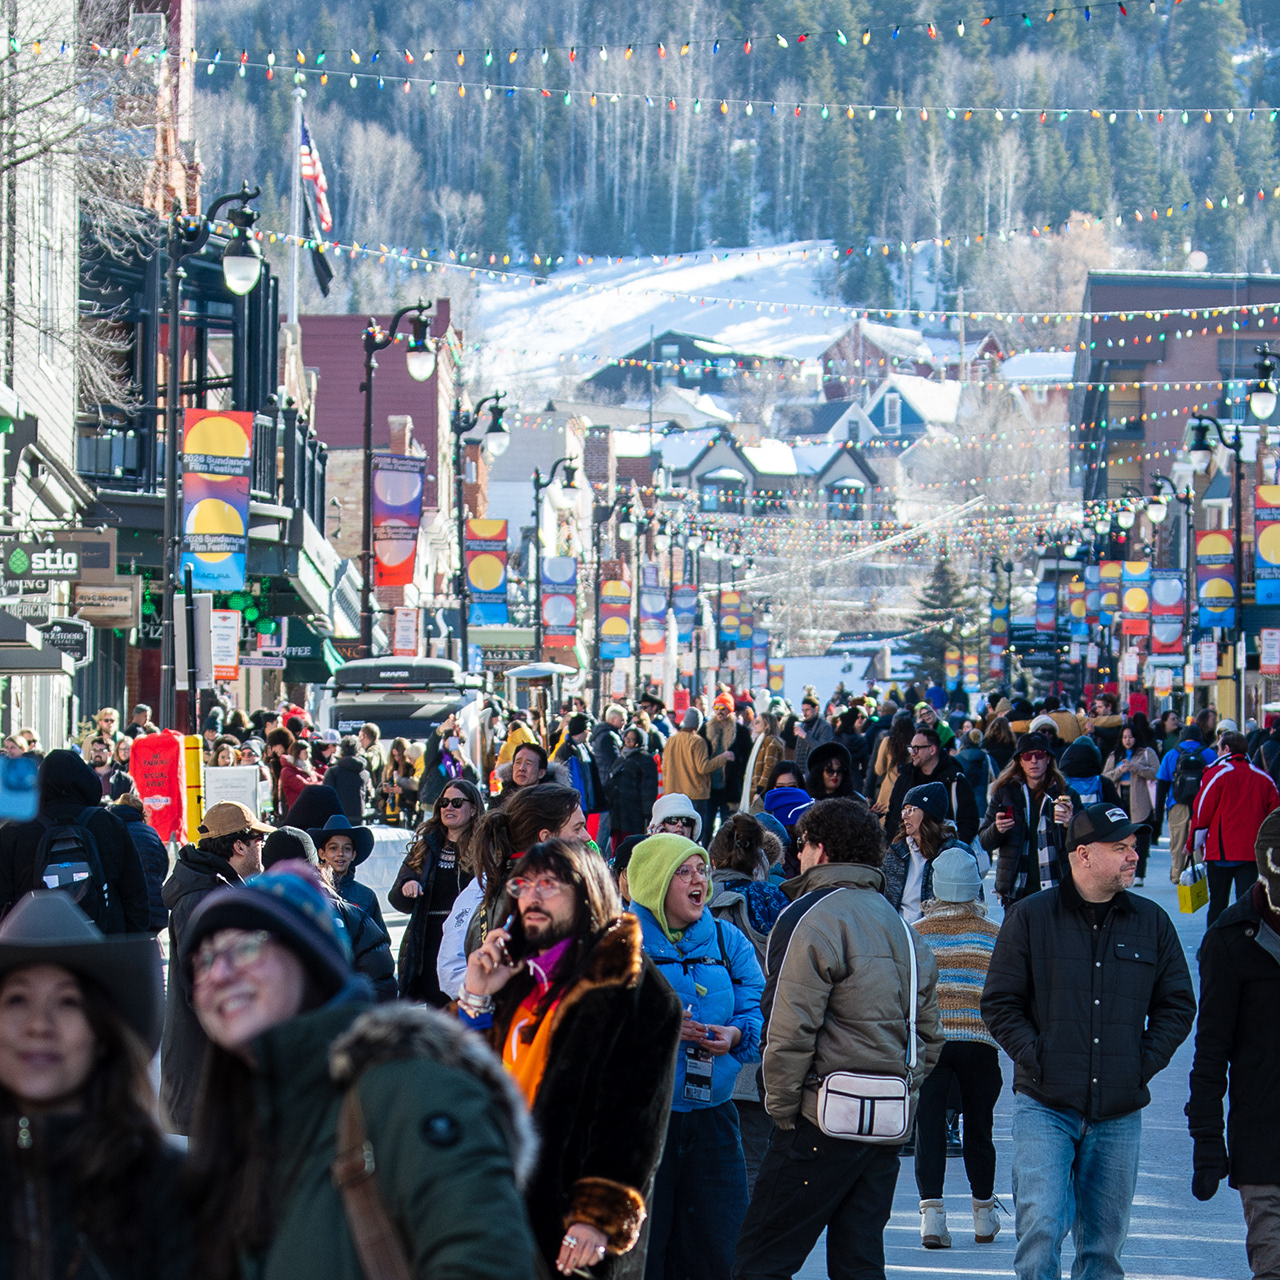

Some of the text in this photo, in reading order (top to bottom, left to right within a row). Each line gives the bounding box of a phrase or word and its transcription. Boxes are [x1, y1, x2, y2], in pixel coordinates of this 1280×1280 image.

[183, 454, 250, 466] 2026 Sundance
[189, 463, 244, 474] Film Festival
[184, 535, 246, 545] 2026 Sundance
[190, 543, 239, 551] Film Festival
[31, 548, 78, 570] stio
